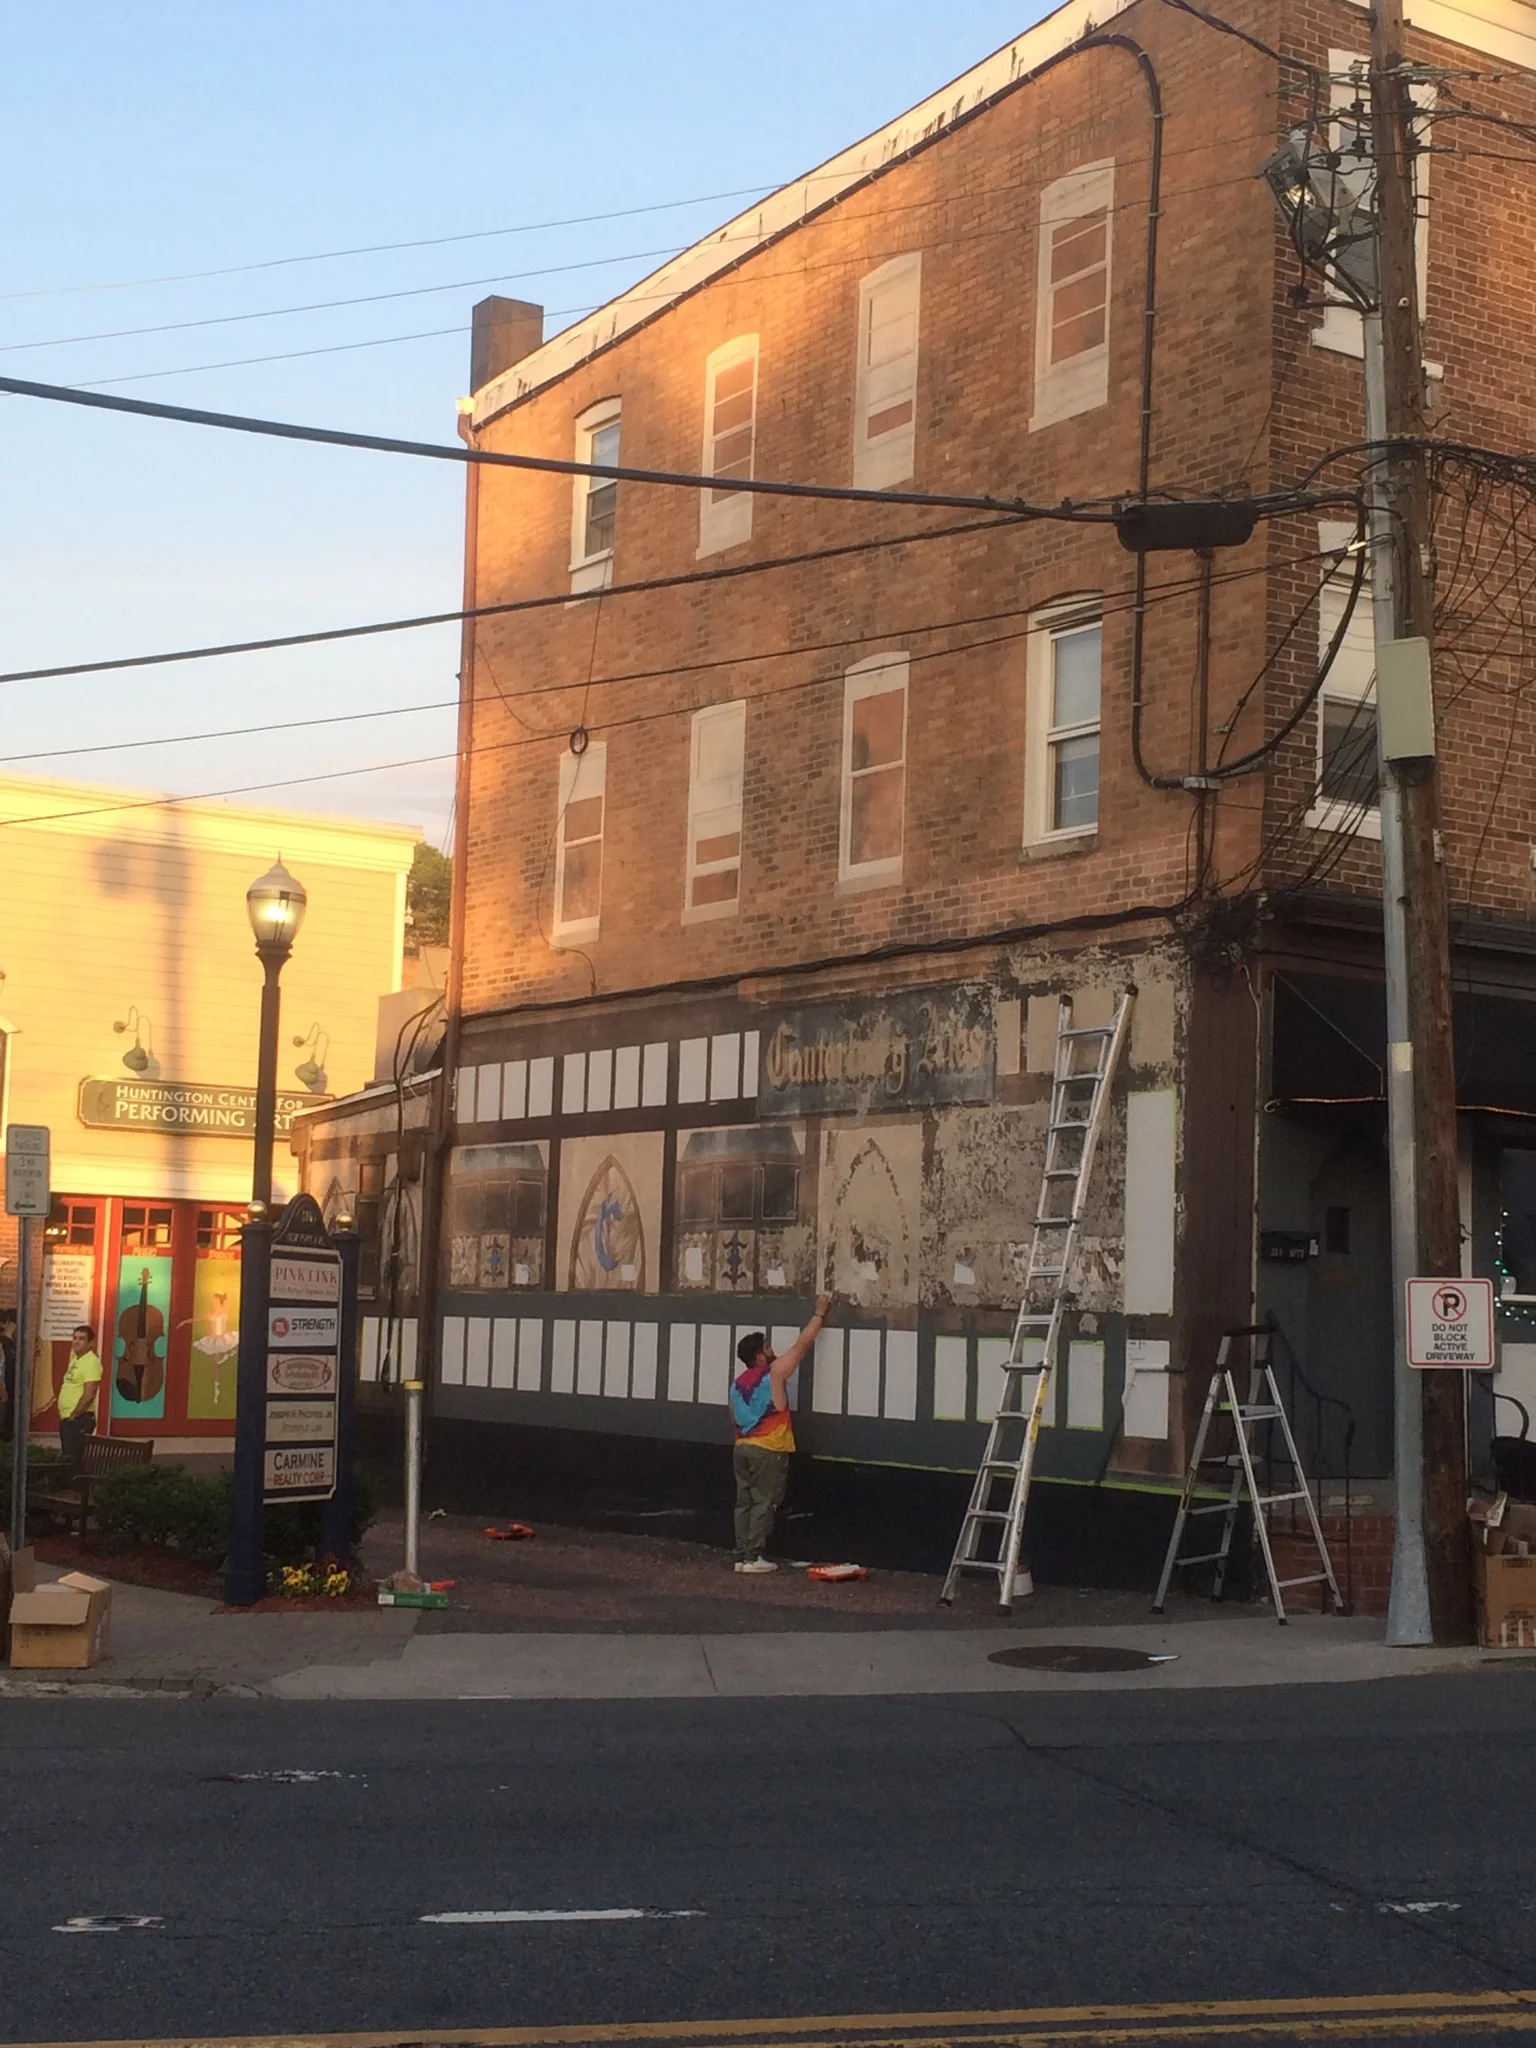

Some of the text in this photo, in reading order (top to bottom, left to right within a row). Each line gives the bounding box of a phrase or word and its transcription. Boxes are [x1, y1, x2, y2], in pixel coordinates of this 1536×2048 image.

[218, 1092, 257, 1108] CENT
[114, 1101, 246, 1127] PERFORMING
[275, 1266, 338, 1285] PINK LINK
[291, 1318, 336, 1331] STRENGTH
[1431, 1323, 1468, 1332] DO NOT
[1433, 1333, 1468, 1341] BLOCK
[1433, 1342, 1468, 1351] ACTIVE
[1425, 1352, 1476, 1360] DRIVEWAY
[273, 1451, 325, 1471] CARMINE
[272, 1472, 301, 1486] REALTY
